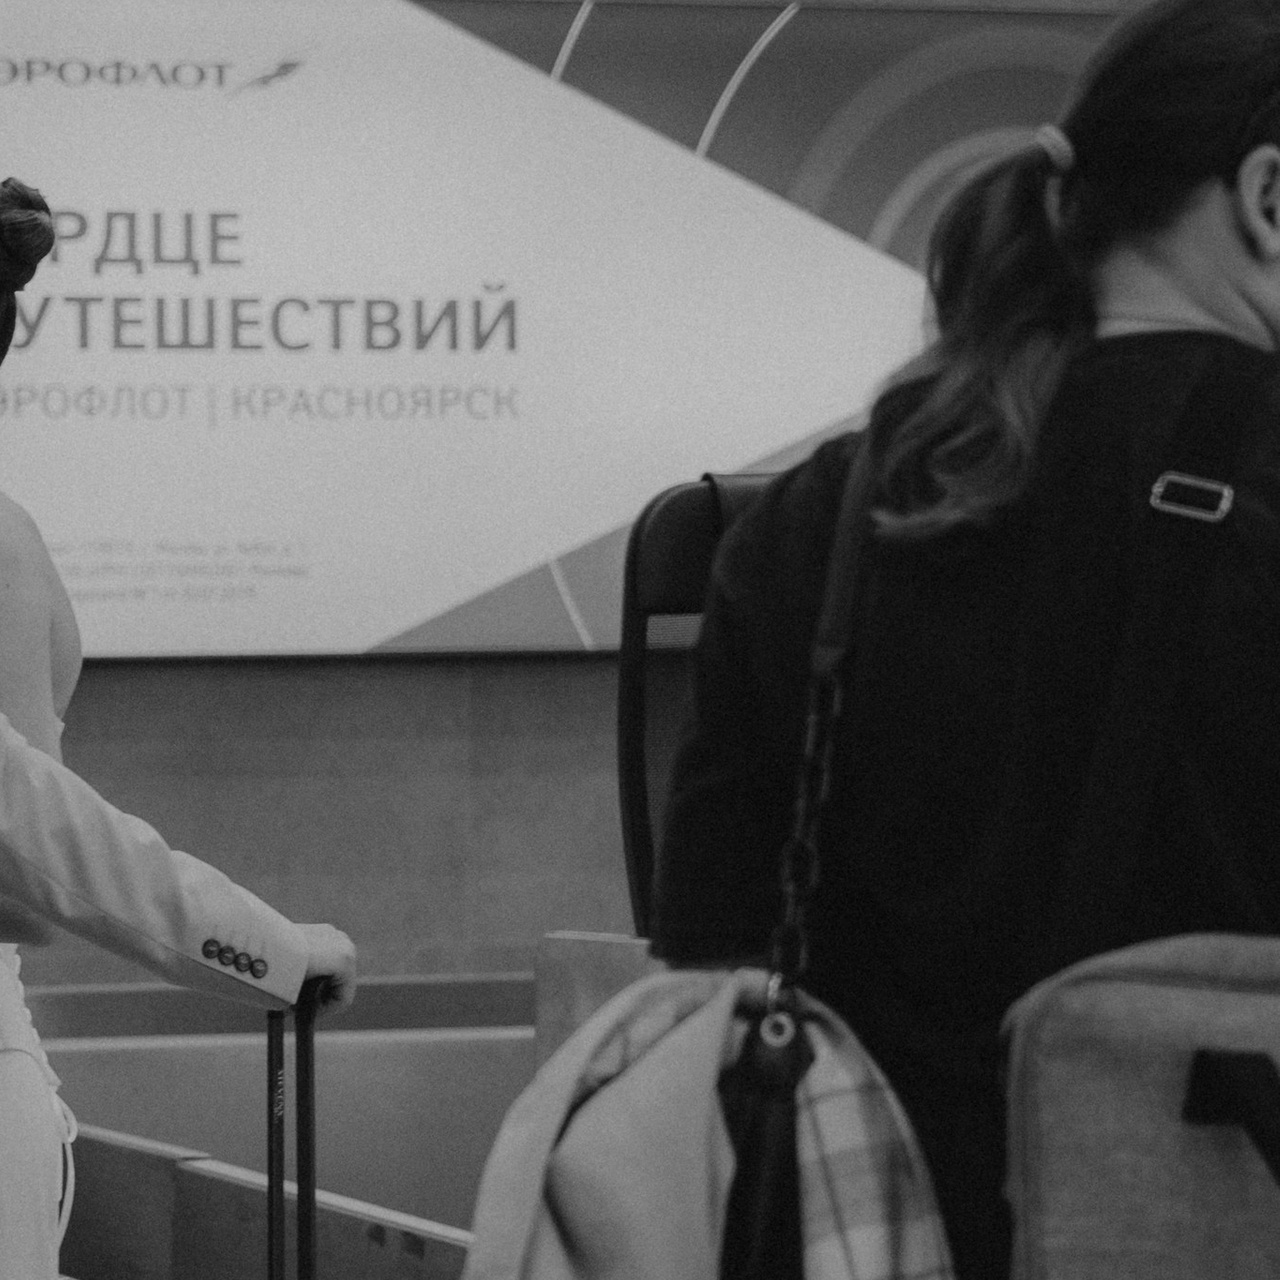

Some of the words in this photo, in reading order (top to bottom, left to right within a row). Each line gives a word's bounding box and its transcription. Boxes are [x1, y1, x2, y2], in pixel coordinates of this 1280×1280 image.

[48, 211, 243, 275] РДЦЕ
[15, 283, 518, 351] УТЕШЕСТВИЙ
[230, 384, 522, 421] КРАСНОЯРСК
